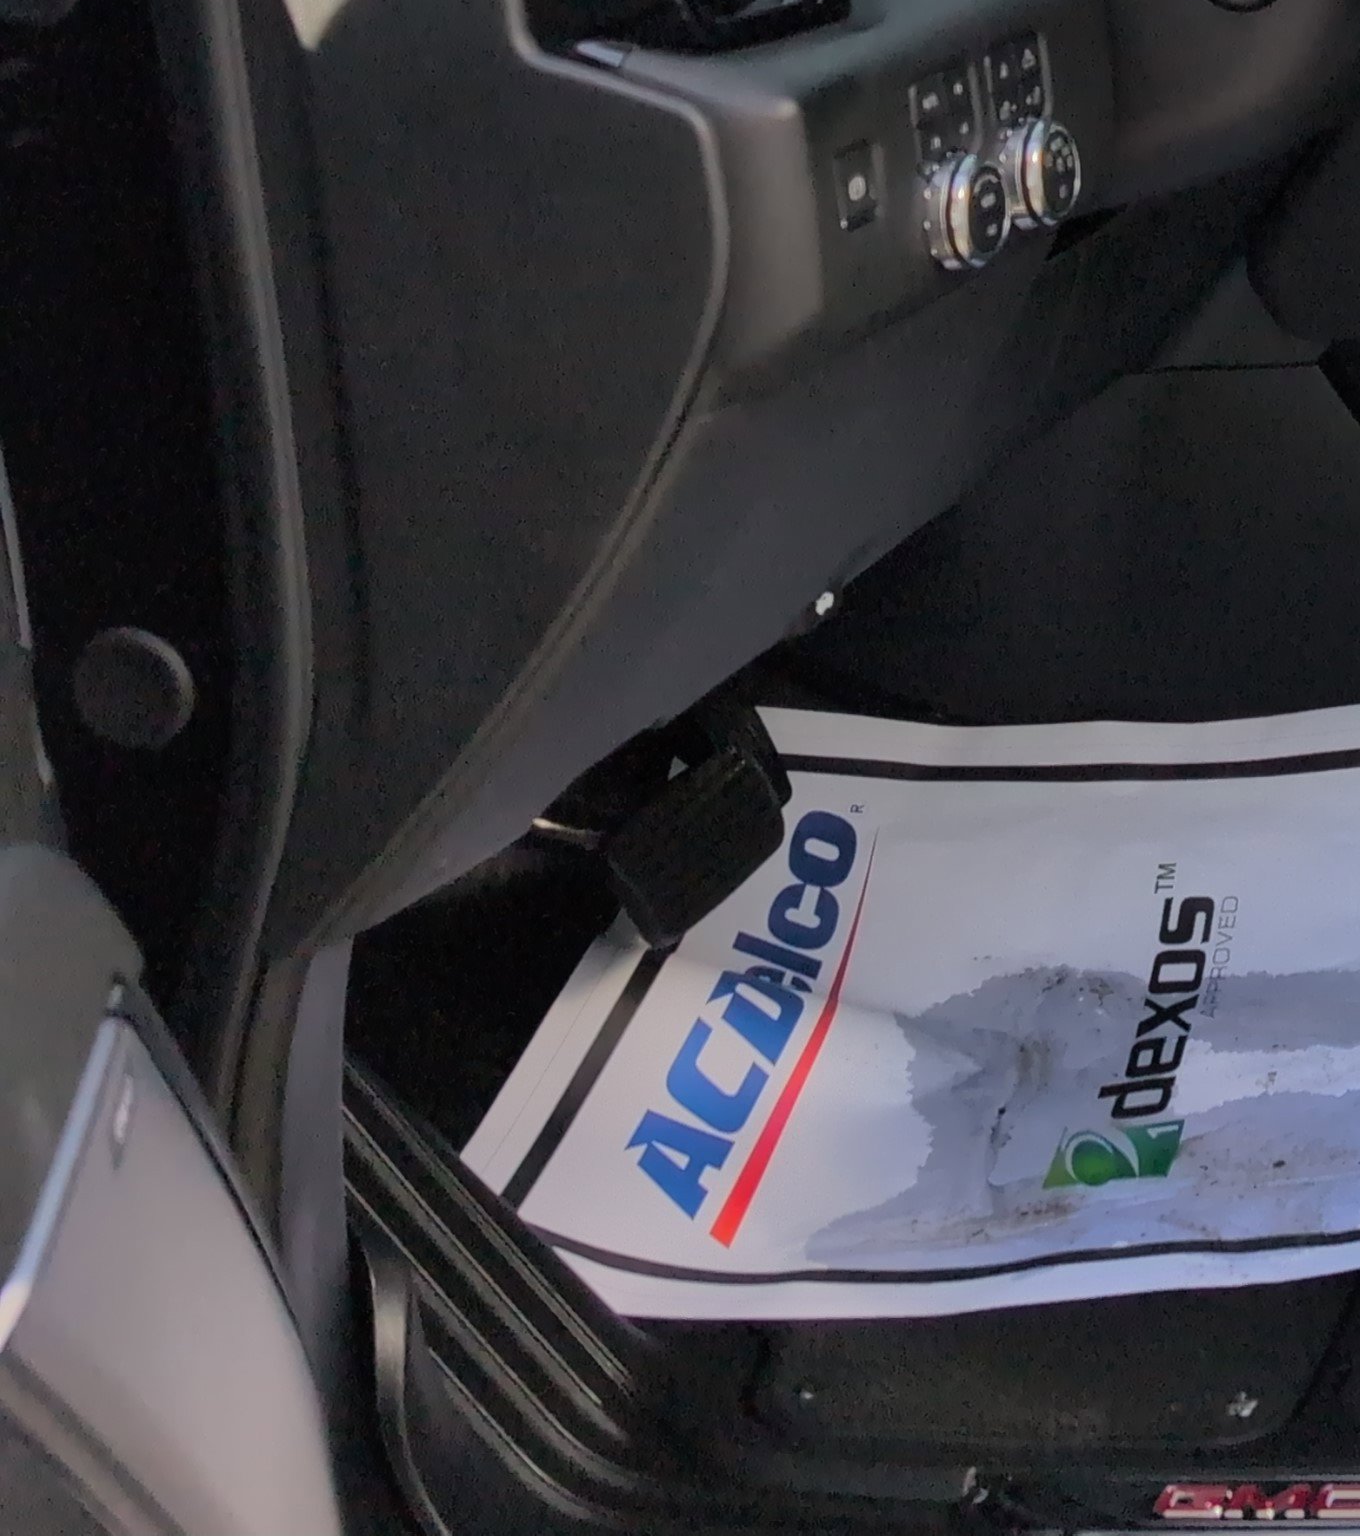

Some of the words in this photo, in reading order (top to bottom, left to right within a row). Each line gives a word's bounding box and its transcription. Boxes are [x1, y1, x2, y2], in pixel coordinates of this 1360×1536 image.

[624, 810, 857, 1220] ACDelco
[1098, 896, 1215, 1119] dexos
[1202, 895, 1239, 1019] APPROVED
